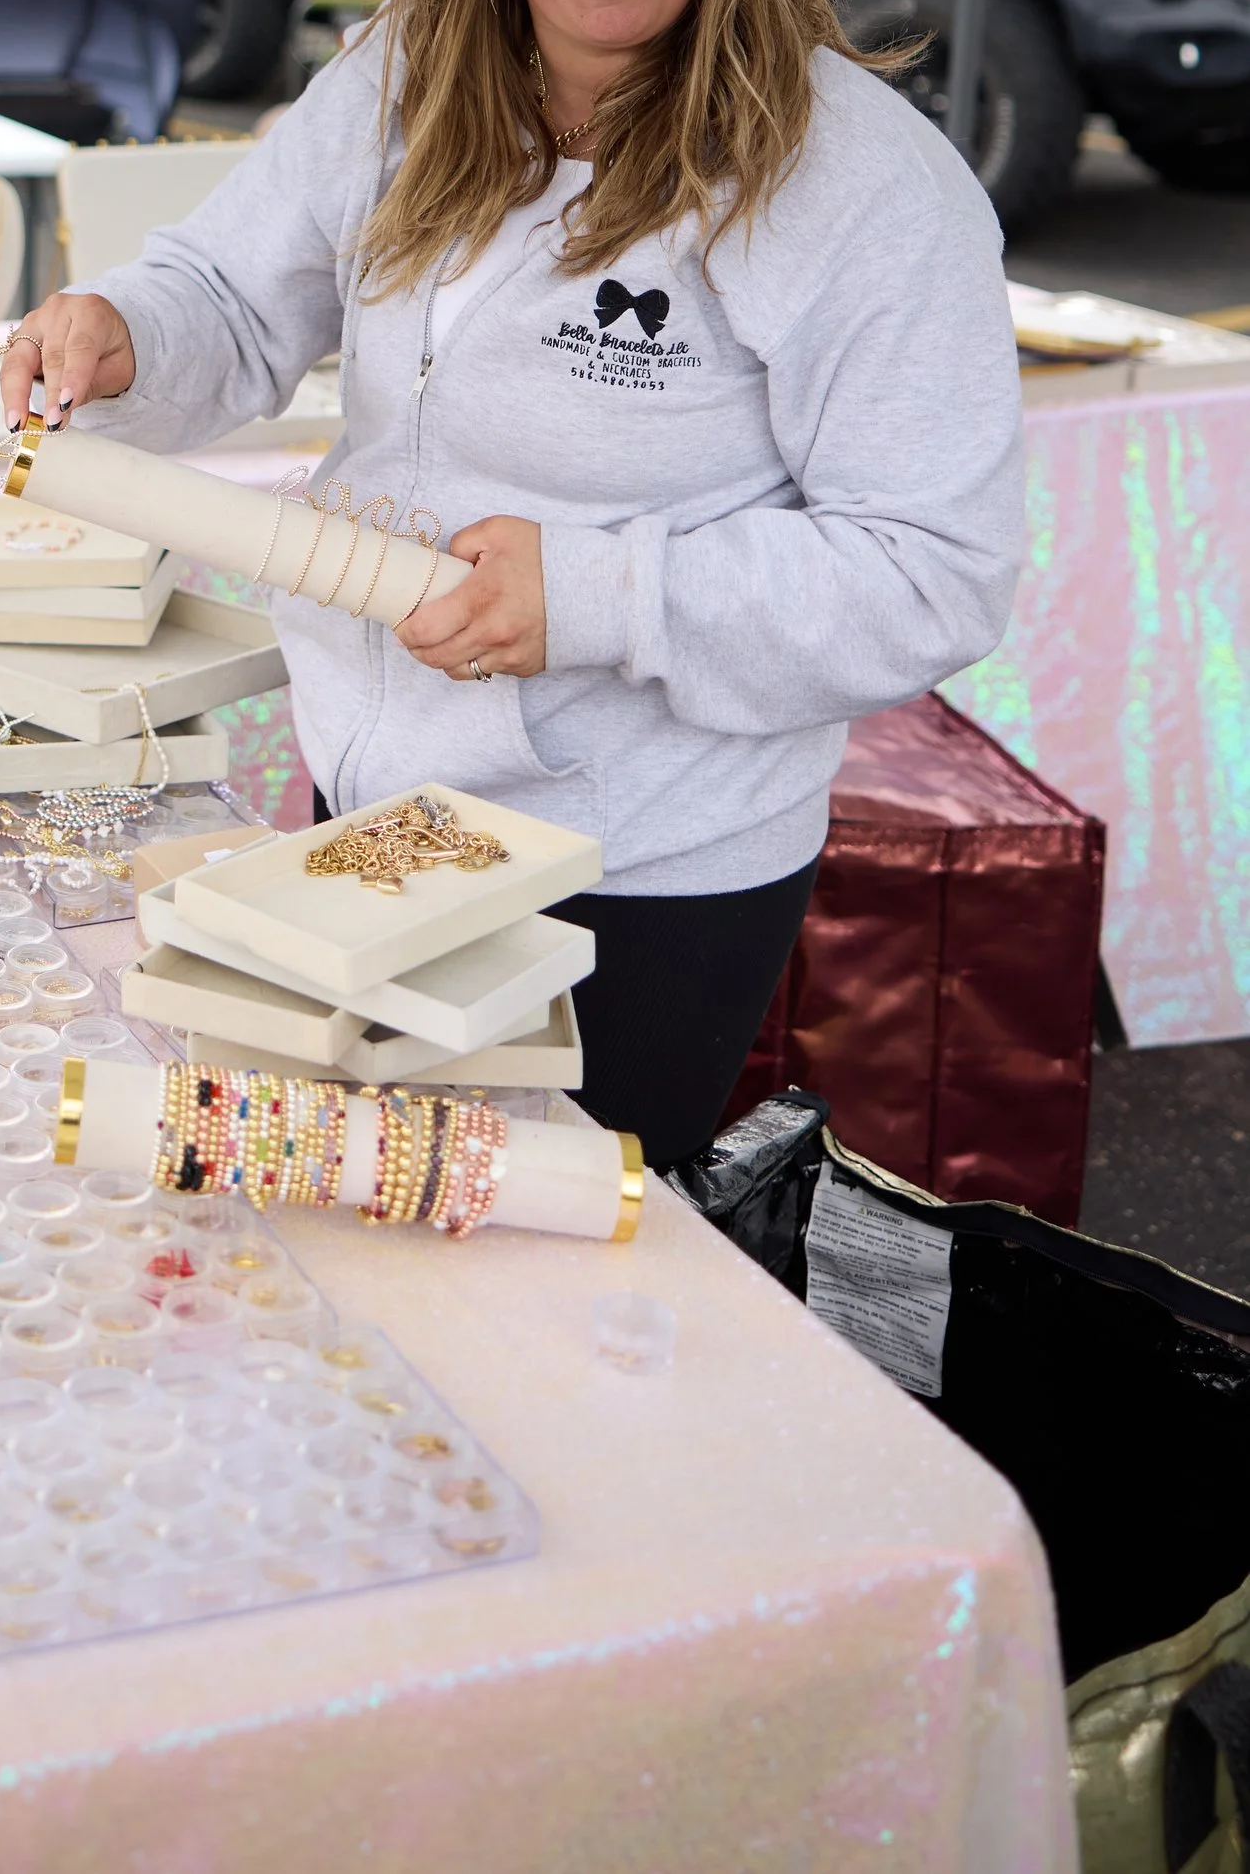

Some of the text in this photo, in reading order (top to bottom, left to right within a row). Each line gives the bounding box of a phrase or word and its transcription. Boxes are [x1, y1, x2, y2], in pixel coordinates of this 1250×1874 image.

[558, 321, 597, 345] Bella
[599, 332, 665, 357] Bracelets
[541, 336, 702, 368] HANDMADE & CUSTOM BRACELETS
[571, 367, 665, 391] 586.480.9053
[587, 360, 652, 379] & NECKLACES
[866, 1208, 904, 1227] WARNING
[854, 1273, 911, 1291] ADVERTENCIA
